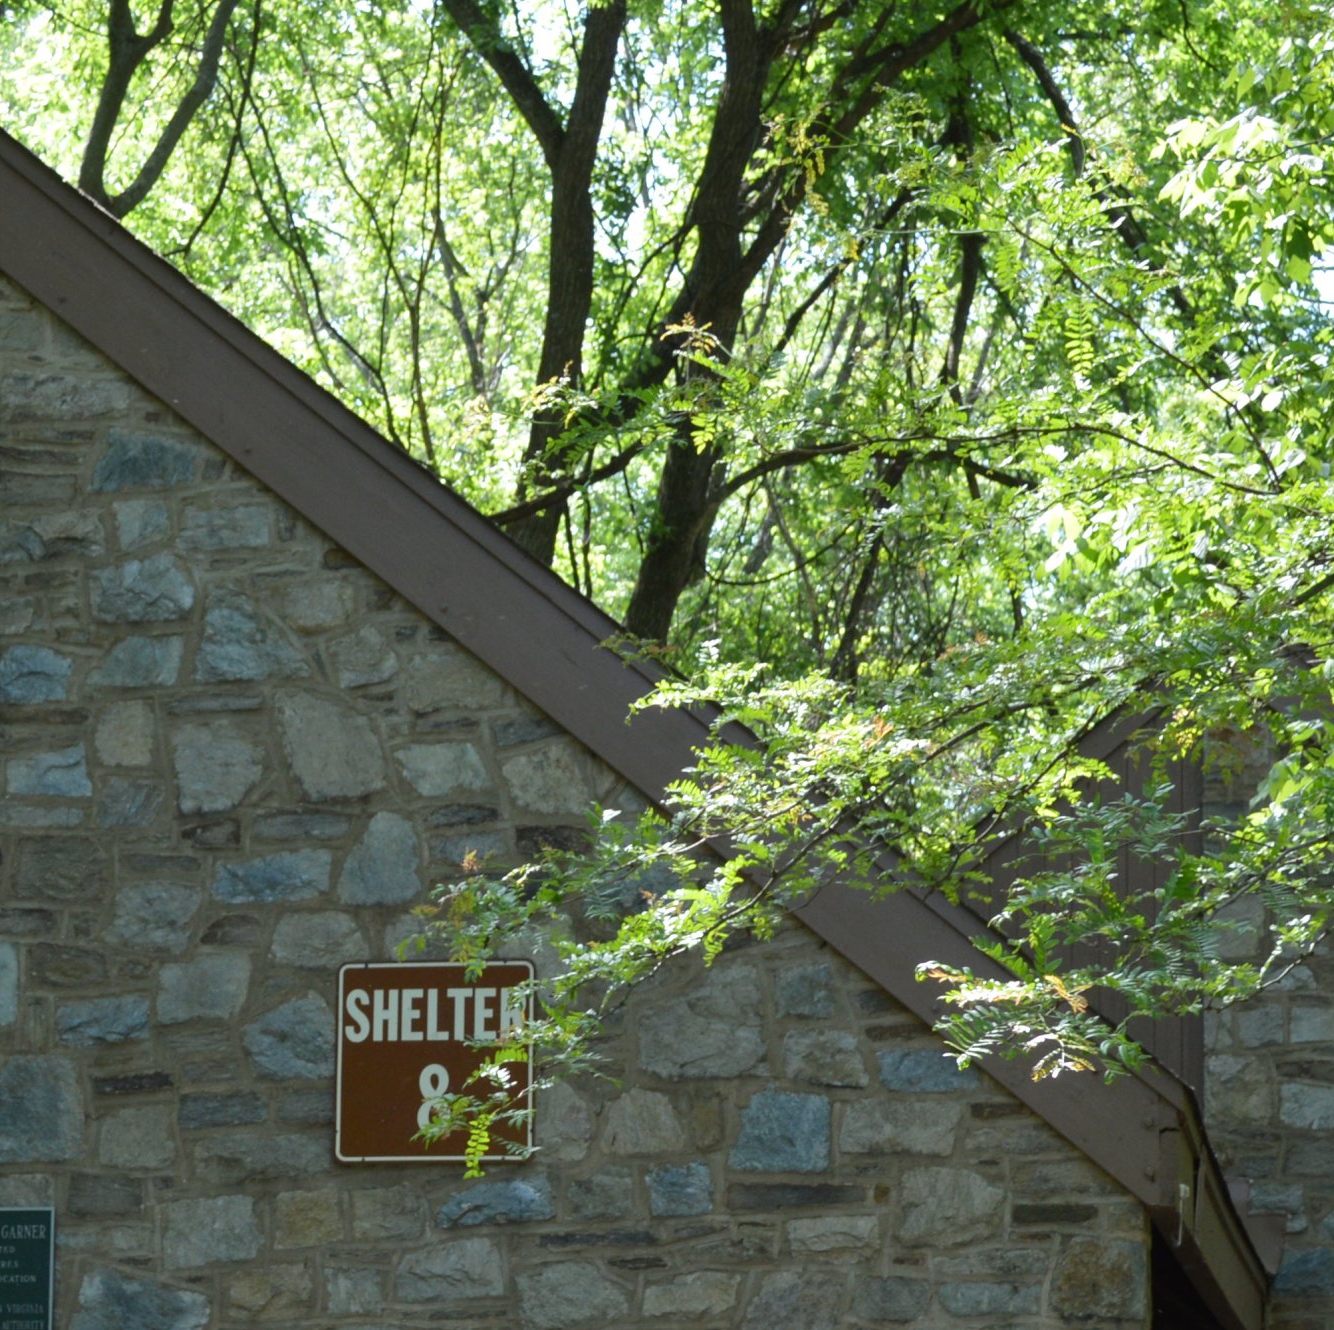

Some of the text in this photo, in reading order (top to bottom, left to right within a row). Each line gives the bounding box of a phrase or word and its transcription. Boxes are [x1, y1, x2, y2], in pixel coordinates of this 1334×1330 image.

[344, 987, 527, 1043] SHELTER
[416, 1063, 451, 1134] 8
[1, 1224, 46, 1240] GARNER
